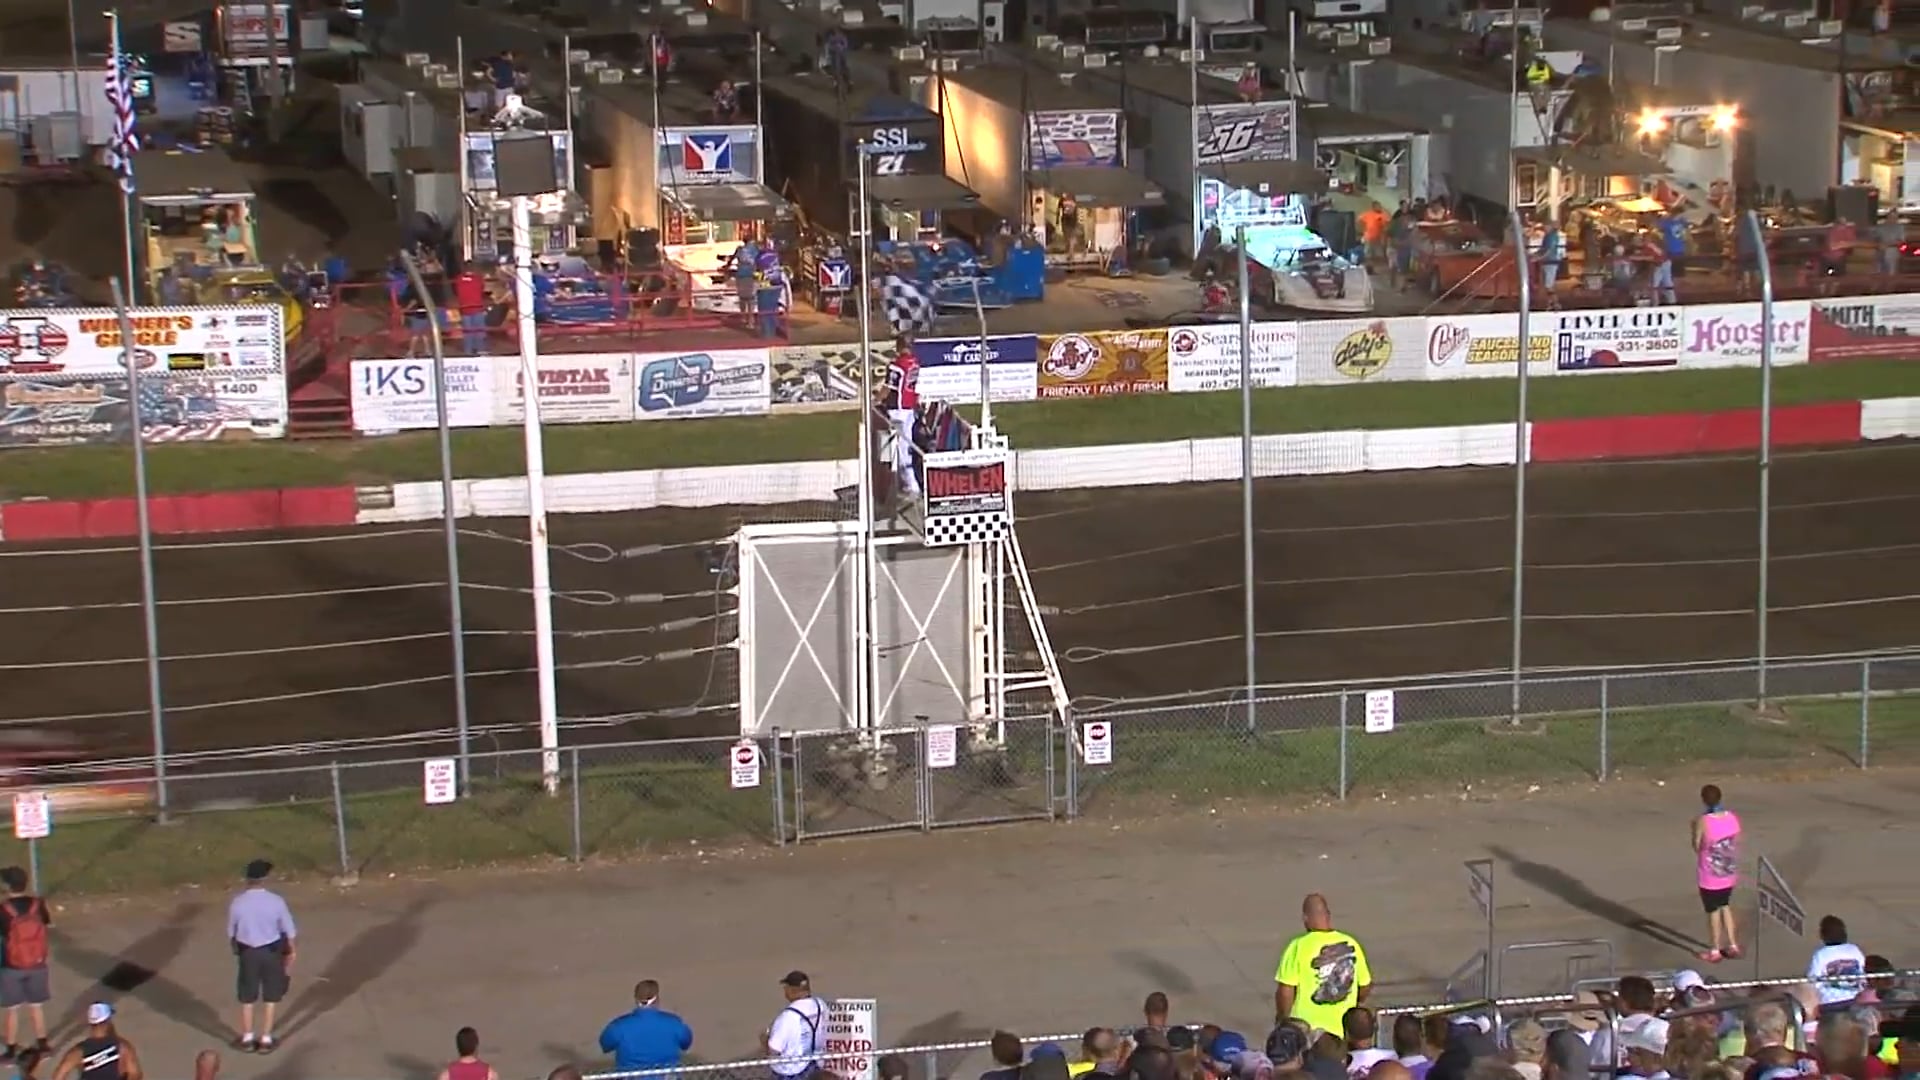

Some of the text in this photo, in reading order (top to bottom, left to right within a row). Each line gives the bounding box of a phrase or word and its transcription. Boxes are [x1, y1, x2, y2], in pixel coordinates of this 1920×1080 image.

[1560, 312, 1676, 330] RIVER CITY
[95, 331, 177, 347] CICLE
[1686, 315, 1806, 352] Hoosier
[1467, 349, 1551, 362] SEASONGS
[1721, 347, 1762, 356] RACIN
[365, 366, 425, 396] IKS
[1043, 386, 1090, 397] FRIENDLY
[1100, 383, 1125, 393] FAST
[1132, 382, 1165, 393] FRESH
[928, 465, 1004, 496] WHELEN
[827, 1002, 872, 1012] DSTAND
[829, 1013, 855, 1022] NTER
[826, 1039, 872, 1053] ERVED
[823, 1057, 868, 1071] ATING
